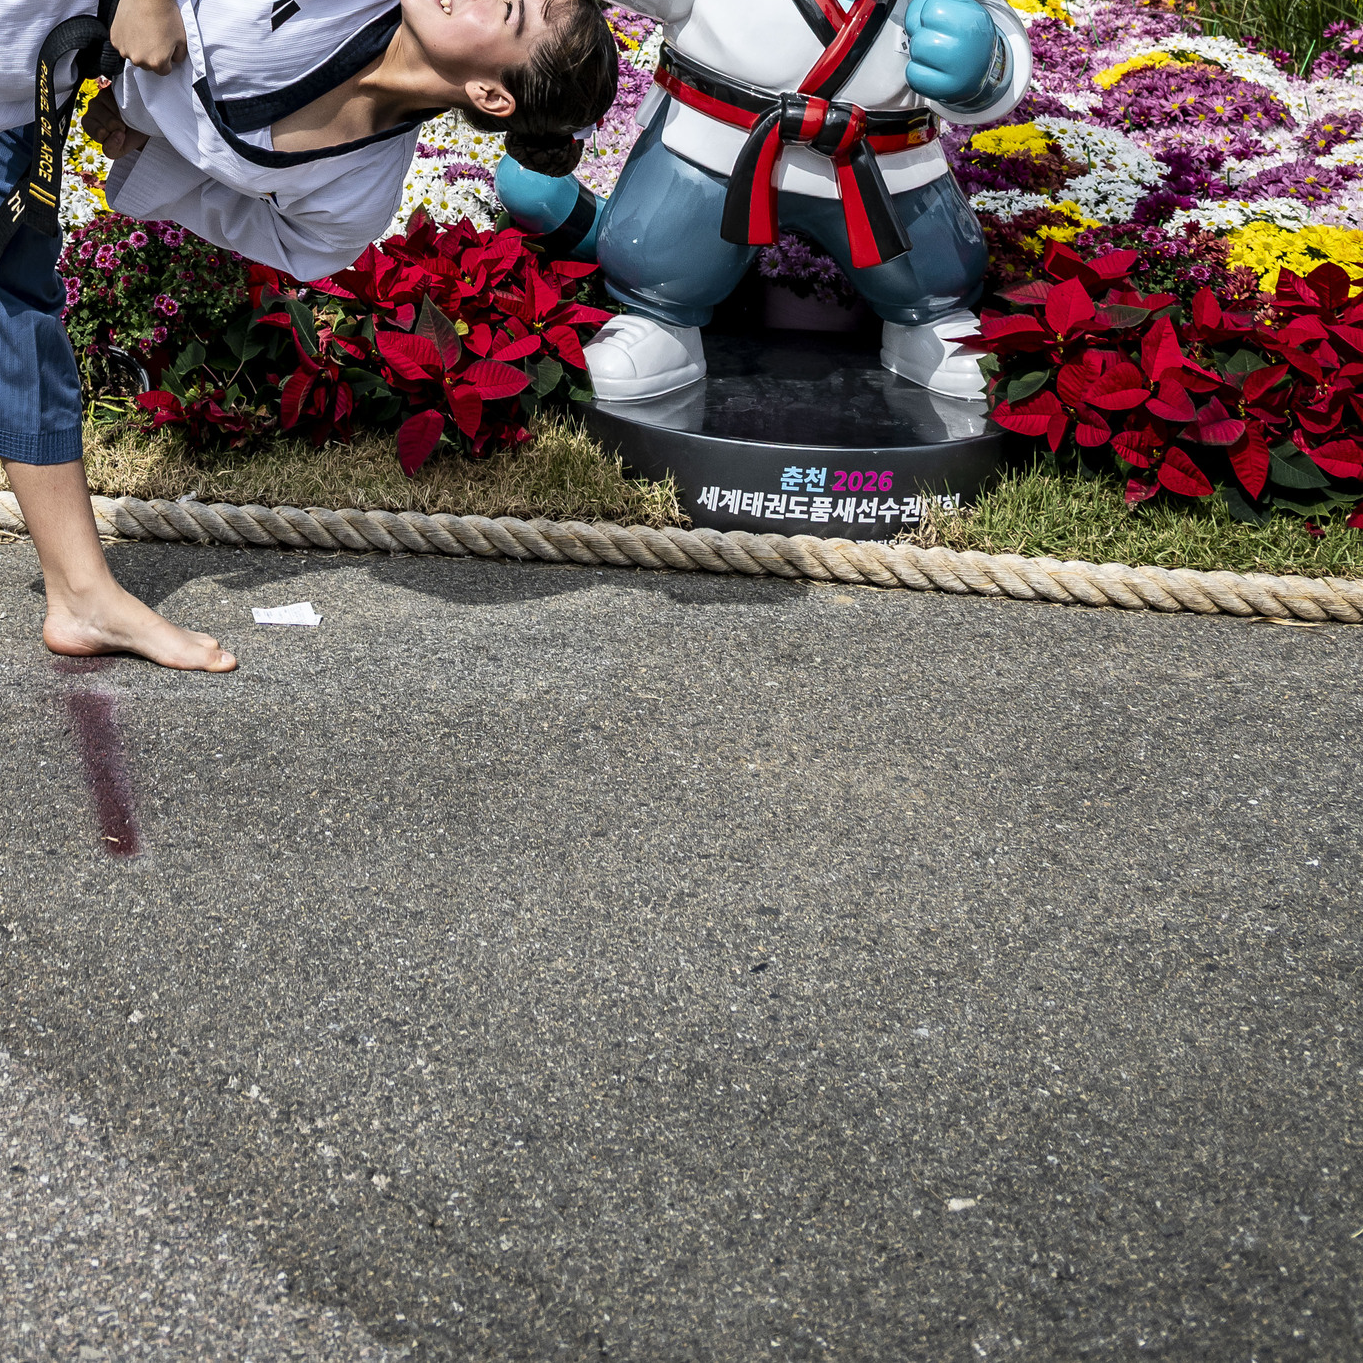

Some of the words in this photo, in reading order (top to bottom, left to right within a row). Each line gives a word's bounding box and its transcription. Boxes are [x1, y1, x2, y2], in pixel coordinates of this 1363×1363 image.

[39, 59, 50, 113] RAQUEL
[40, 116, 52, 137] GIL
[38, 139, 54, 183] ARCE
[779, 465, 829, 493] 춘천
[831, 470, 895, 492] 2026
